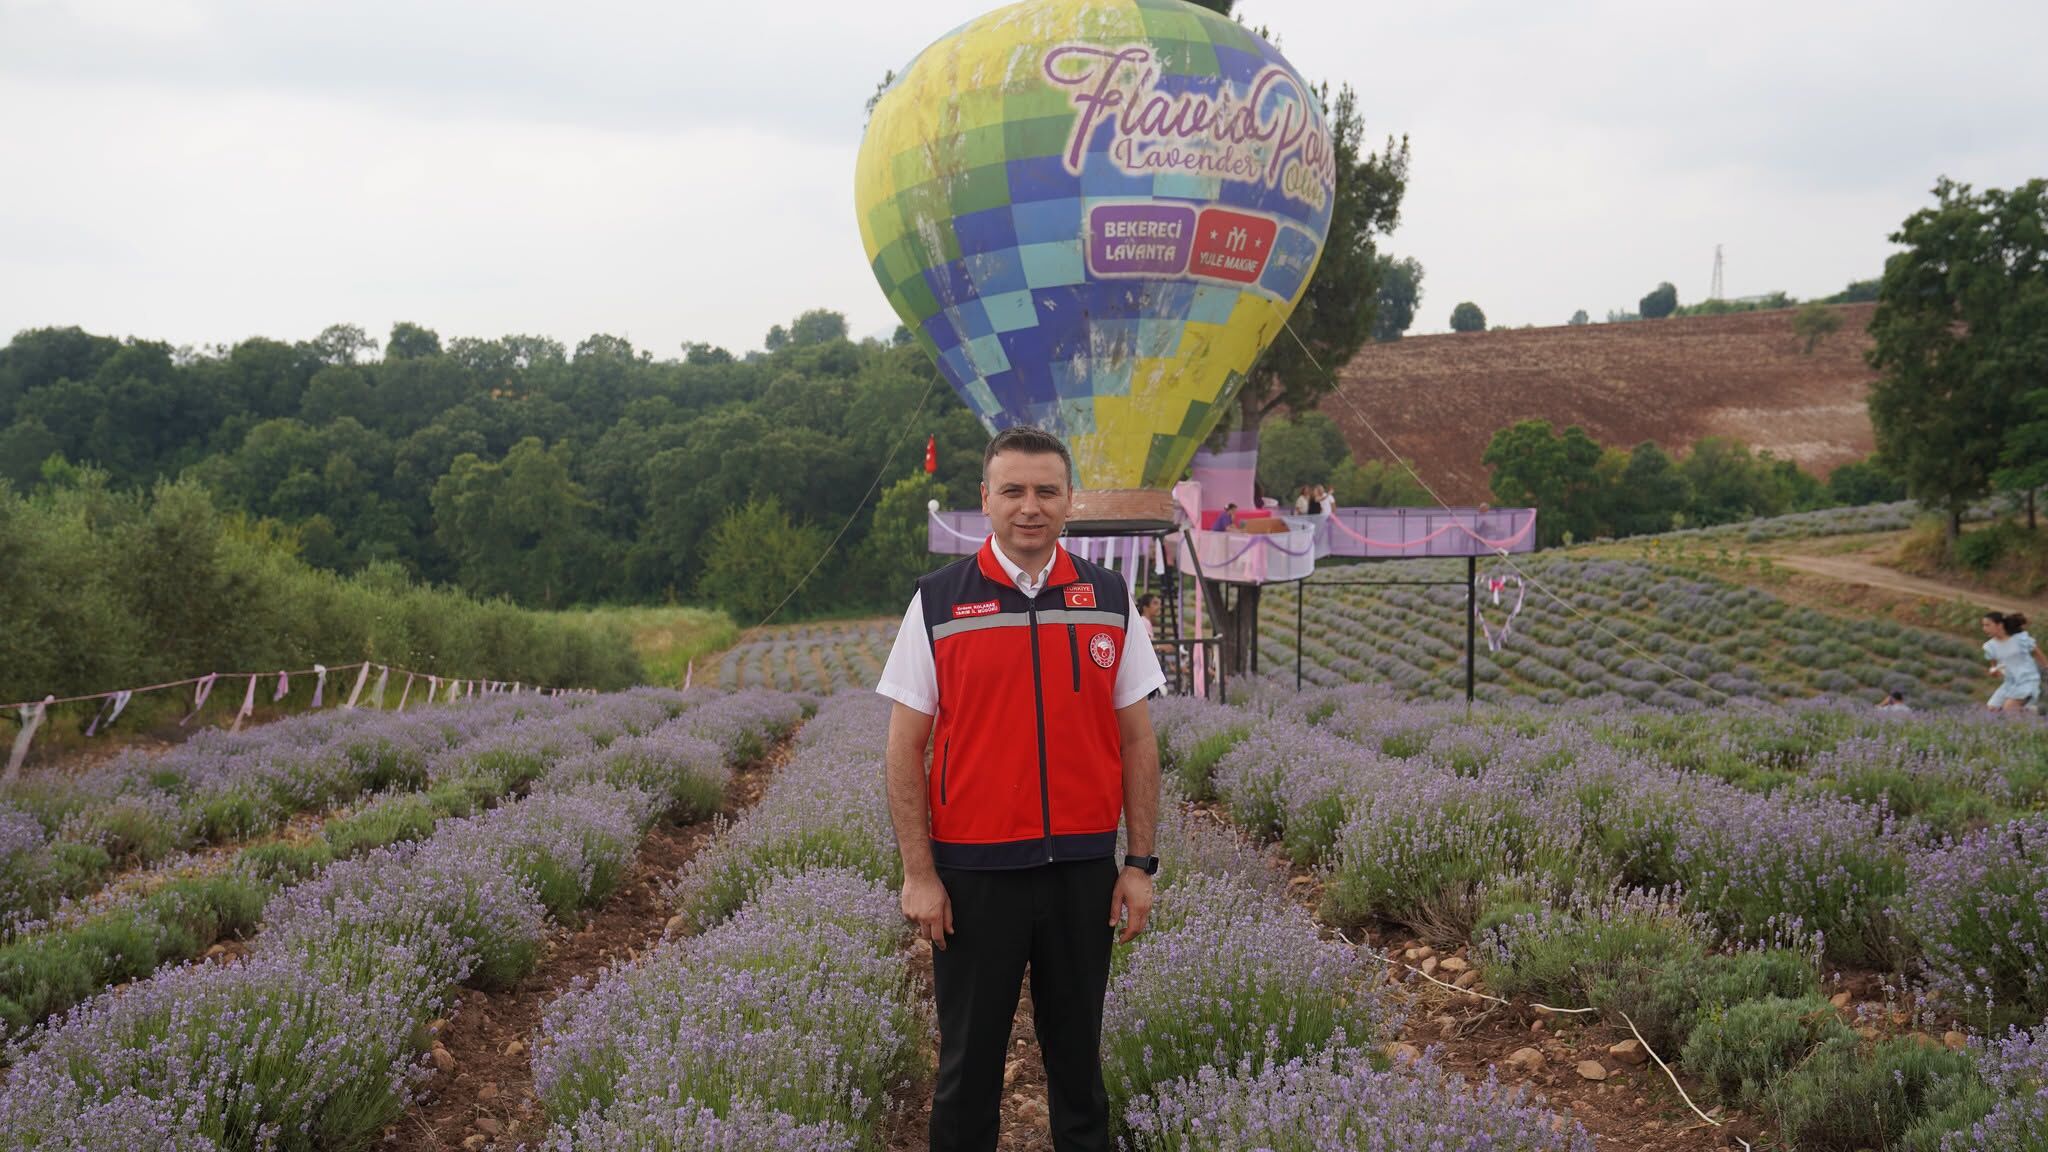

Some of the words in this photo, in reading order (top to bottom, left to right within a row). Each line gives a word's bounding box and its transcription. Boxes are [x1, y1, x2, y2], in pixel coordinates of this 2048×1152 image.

[1115, 138, 1259, 177] Lavender
[1104, 219, 1183, 239] BEKERECİ
[1105, 244, 1177, 262] LAVANTA
